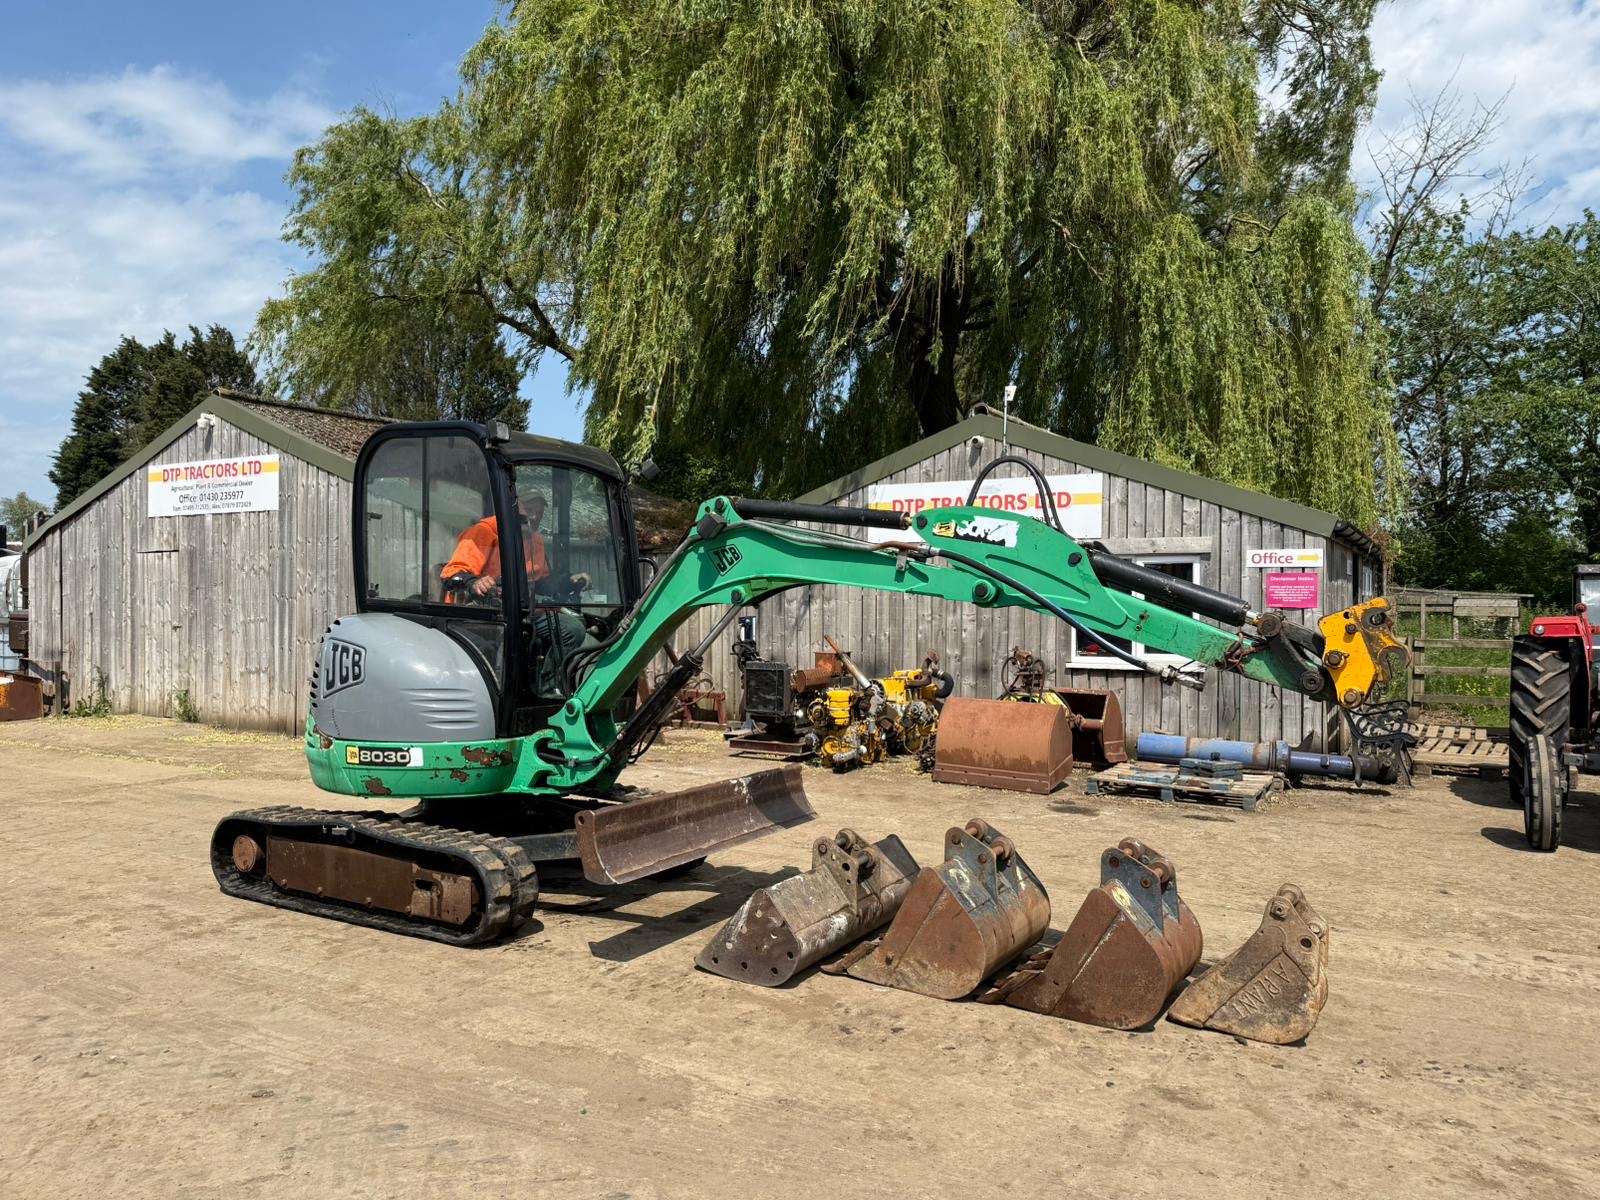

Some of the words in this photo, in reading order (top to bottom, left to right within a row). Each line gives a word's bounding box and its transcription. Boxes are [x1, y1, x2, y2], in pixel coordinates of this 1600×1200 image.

[162, 468, 181, 482] DTP
[184, 462, 238, 480] TRACTORS
[241, 460, 262, 476] LTD
[220, 491, 244, 500] 235977
[892, 498, 925, 513] DTP
[930, 493, 1028, 511] TRATORS
[713, 546, 741, 573] JCB
[1251, 552, 1294, 565] Office
[324, 642, 362, 691] JCB
[360, 750, 411, 764] 8030
